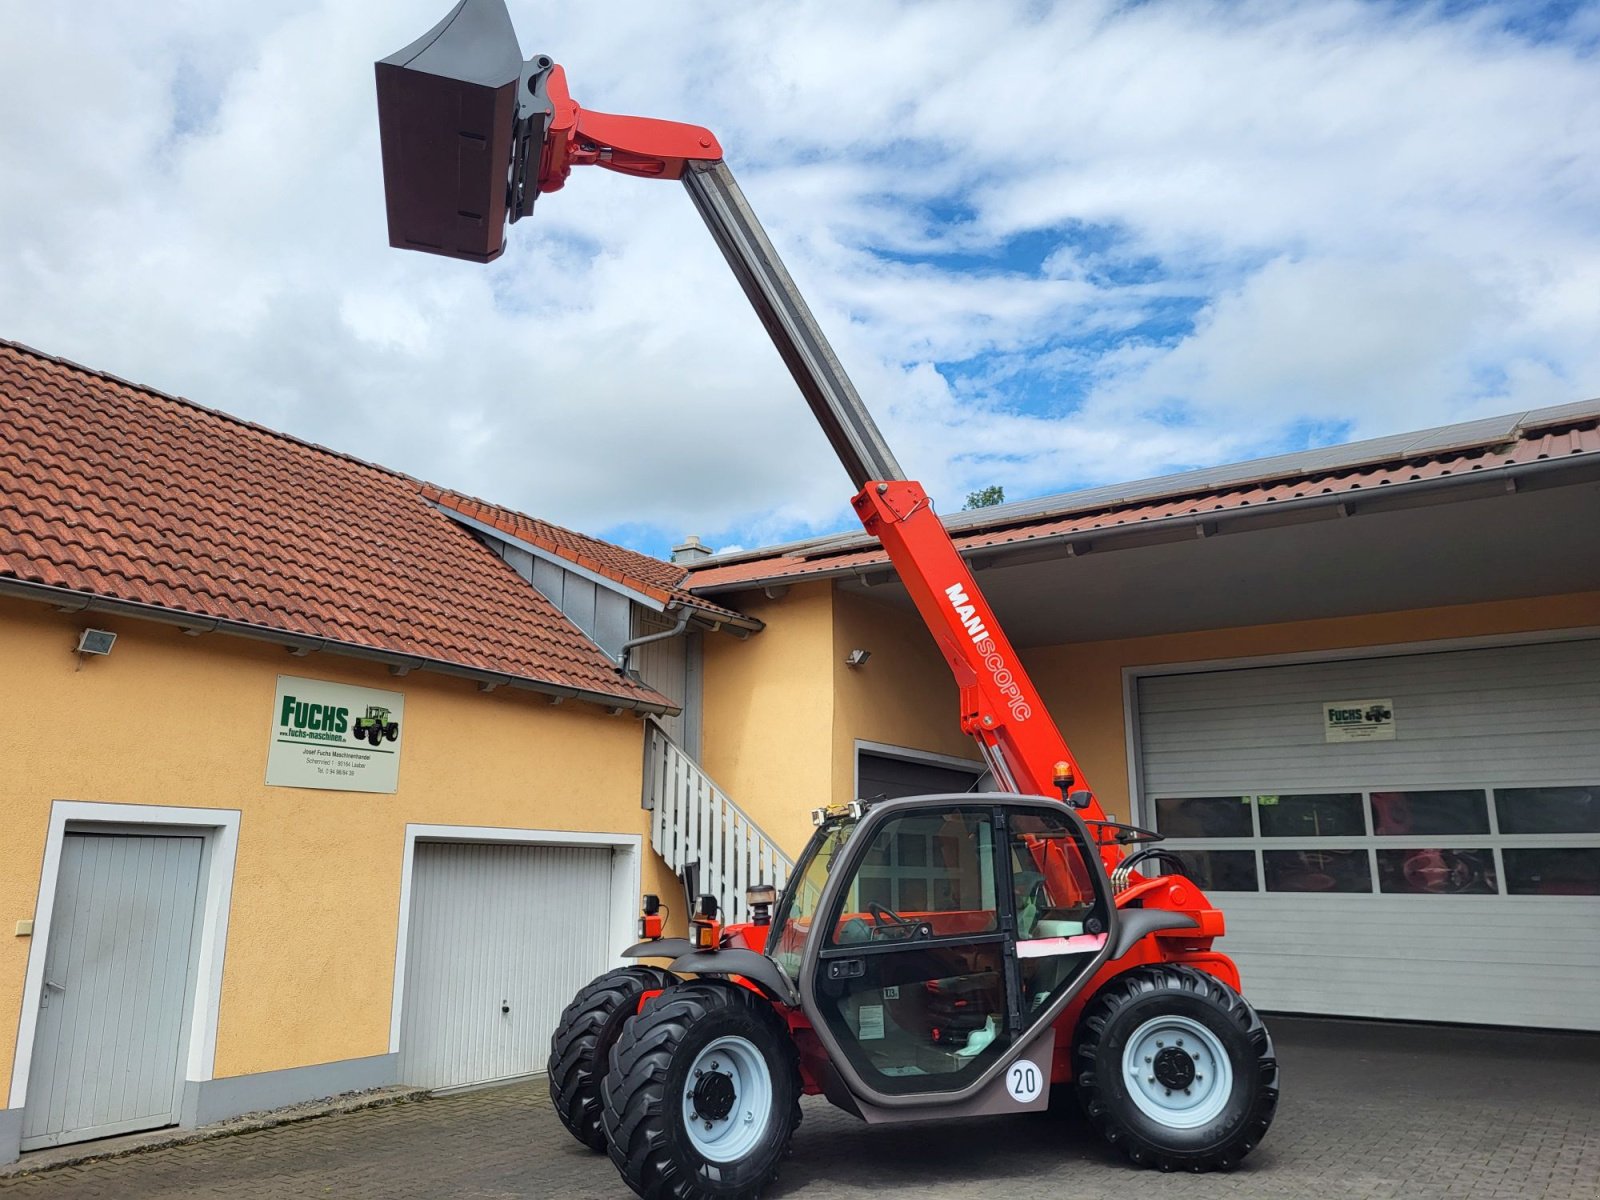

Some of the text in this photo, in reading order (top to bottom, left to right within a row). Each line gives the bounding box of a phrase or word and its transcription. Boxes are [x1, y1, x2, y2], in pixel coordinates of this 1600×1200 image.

[945, 582, 1032, 721] MANISCOPIC
[280, 695, 348, 733] FUCHS
[1328, 709, 1362, 721] FUCHS
[1013, 1068, 1036, 1094] 20
